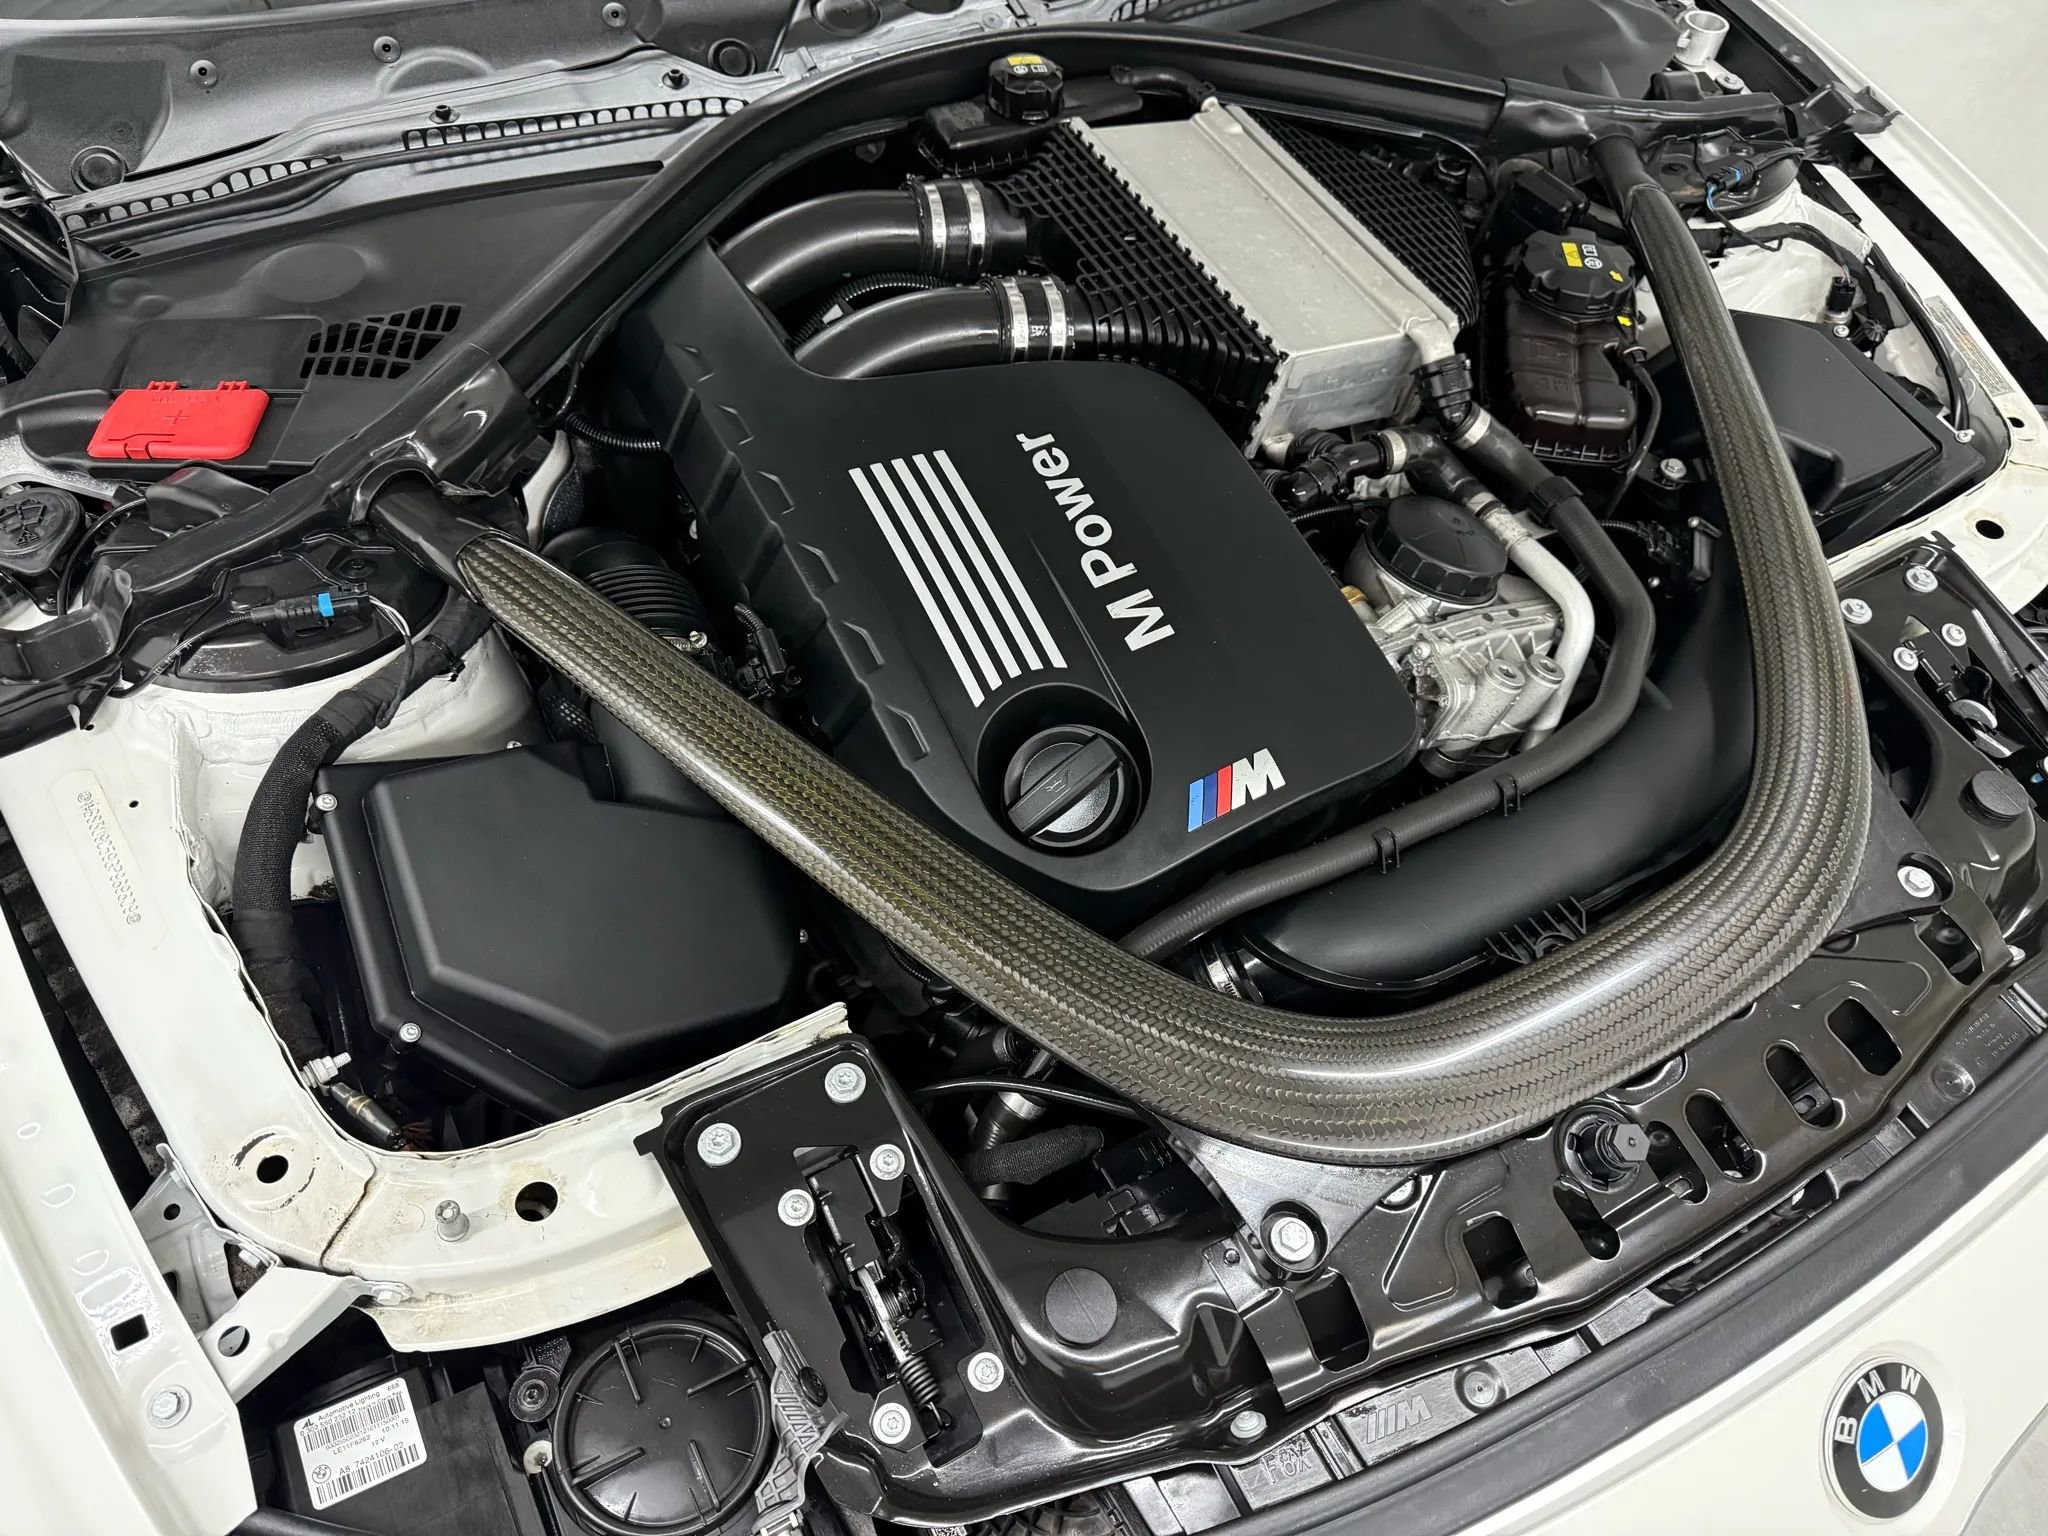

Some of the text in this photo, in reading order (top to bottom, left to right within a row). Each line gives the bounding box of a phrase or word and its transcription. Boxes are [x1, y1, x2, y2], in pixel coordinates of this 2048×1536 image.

[1015, 432, 1176, 652] M Power
[306, 1424, 319, 1434] 302
[348, 1408, 357, 1416] 12
[318, 1402, 354, 1421] Automotive
[354, 1391, 380, 1406] Lighting
[1834, 1365, 1921, 1445] BMW
